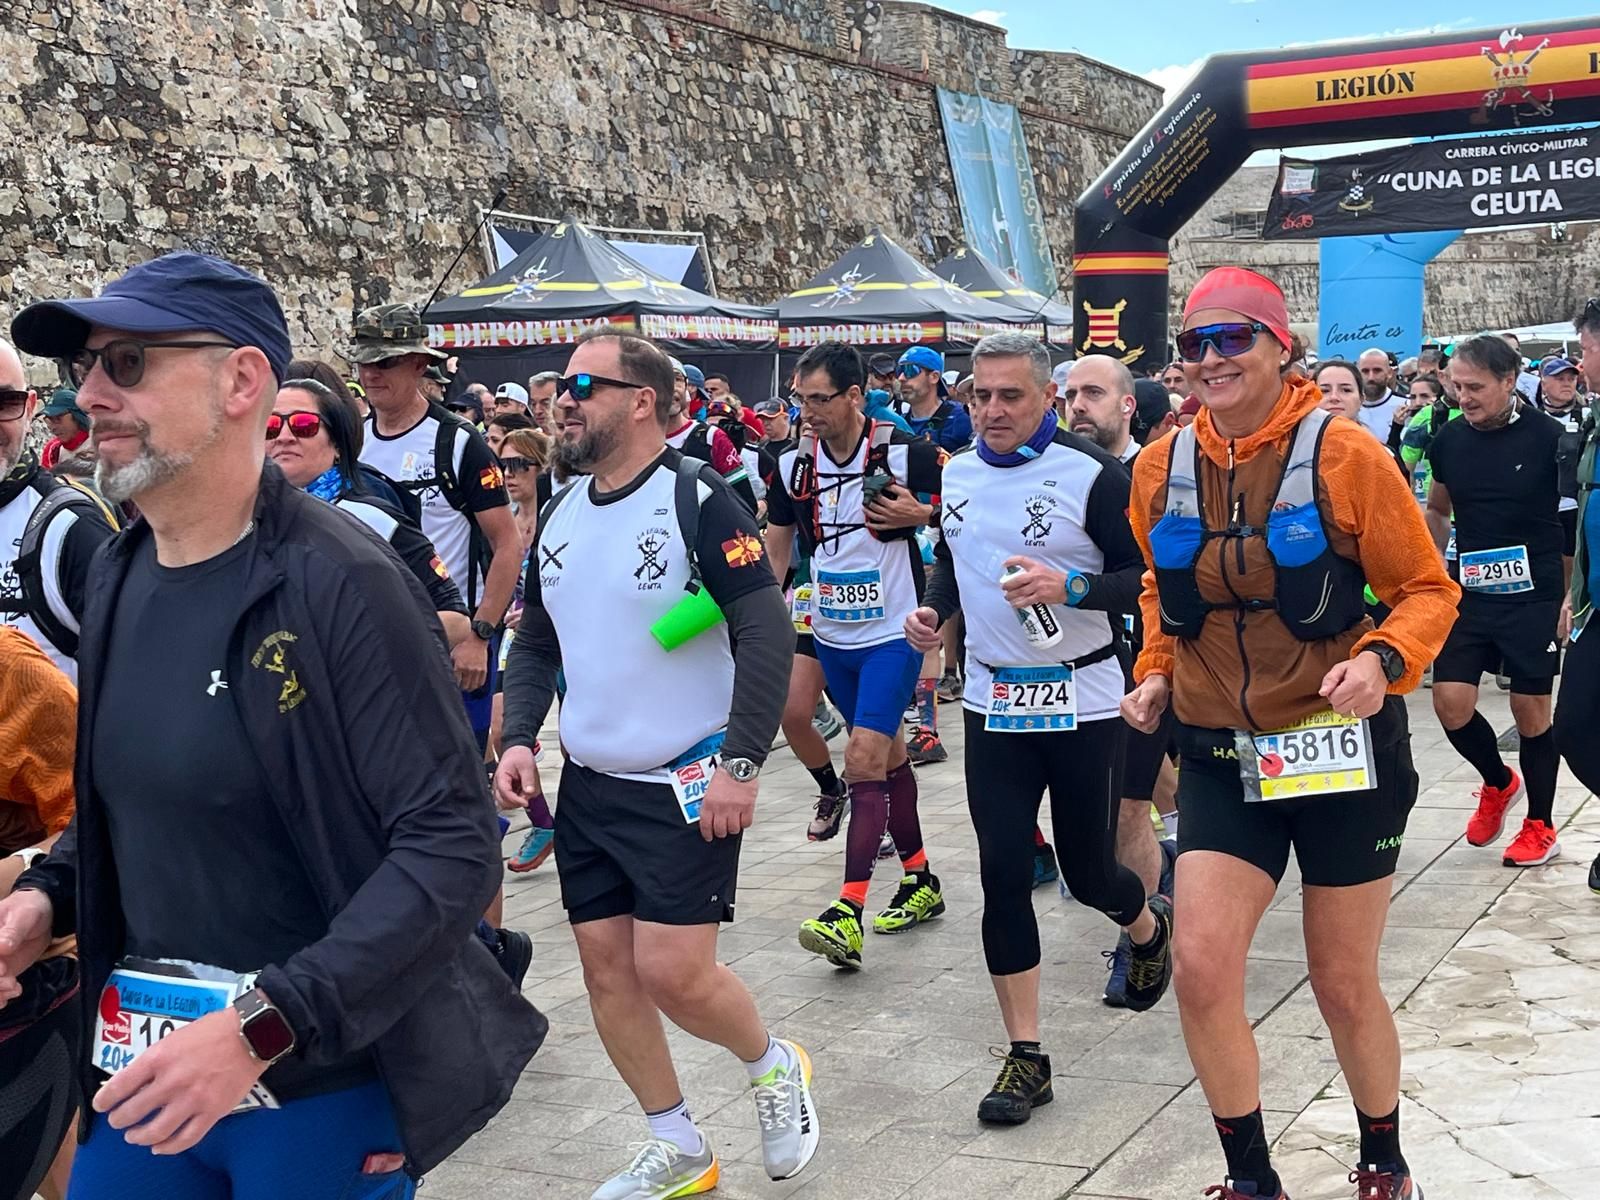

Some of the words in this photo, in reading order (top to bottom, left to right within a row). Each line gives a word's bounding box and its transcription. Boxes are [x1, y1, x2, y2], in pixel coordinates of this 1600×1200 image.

[1316, 69, 1415, 102] LEGIÓN
[1141, 138, 1155, 159] del
[1154, 92, 1202, 144] Legionario
[1445, 146, 1497, 159] CARRERA
[1500, 138, 1588, 155] CÍVICO-MILITAR
[1472, 166, 1502, 186] DE
[1511, 164, 1541, 183] LA
[1470, 189, 1563, 217] CEUTA
[788, 322, 923, 347] DEPORTIVO
[1326, 322, 1381, 346] Ceuta
[1385, 326, 1404, 337] es
[1482, 560, 1524, 580] 2916
[836, 583, 879, 604] 3895
[1013, 682, 1069, 707] 2724
[1283, 728, 1359, 765] 5816
